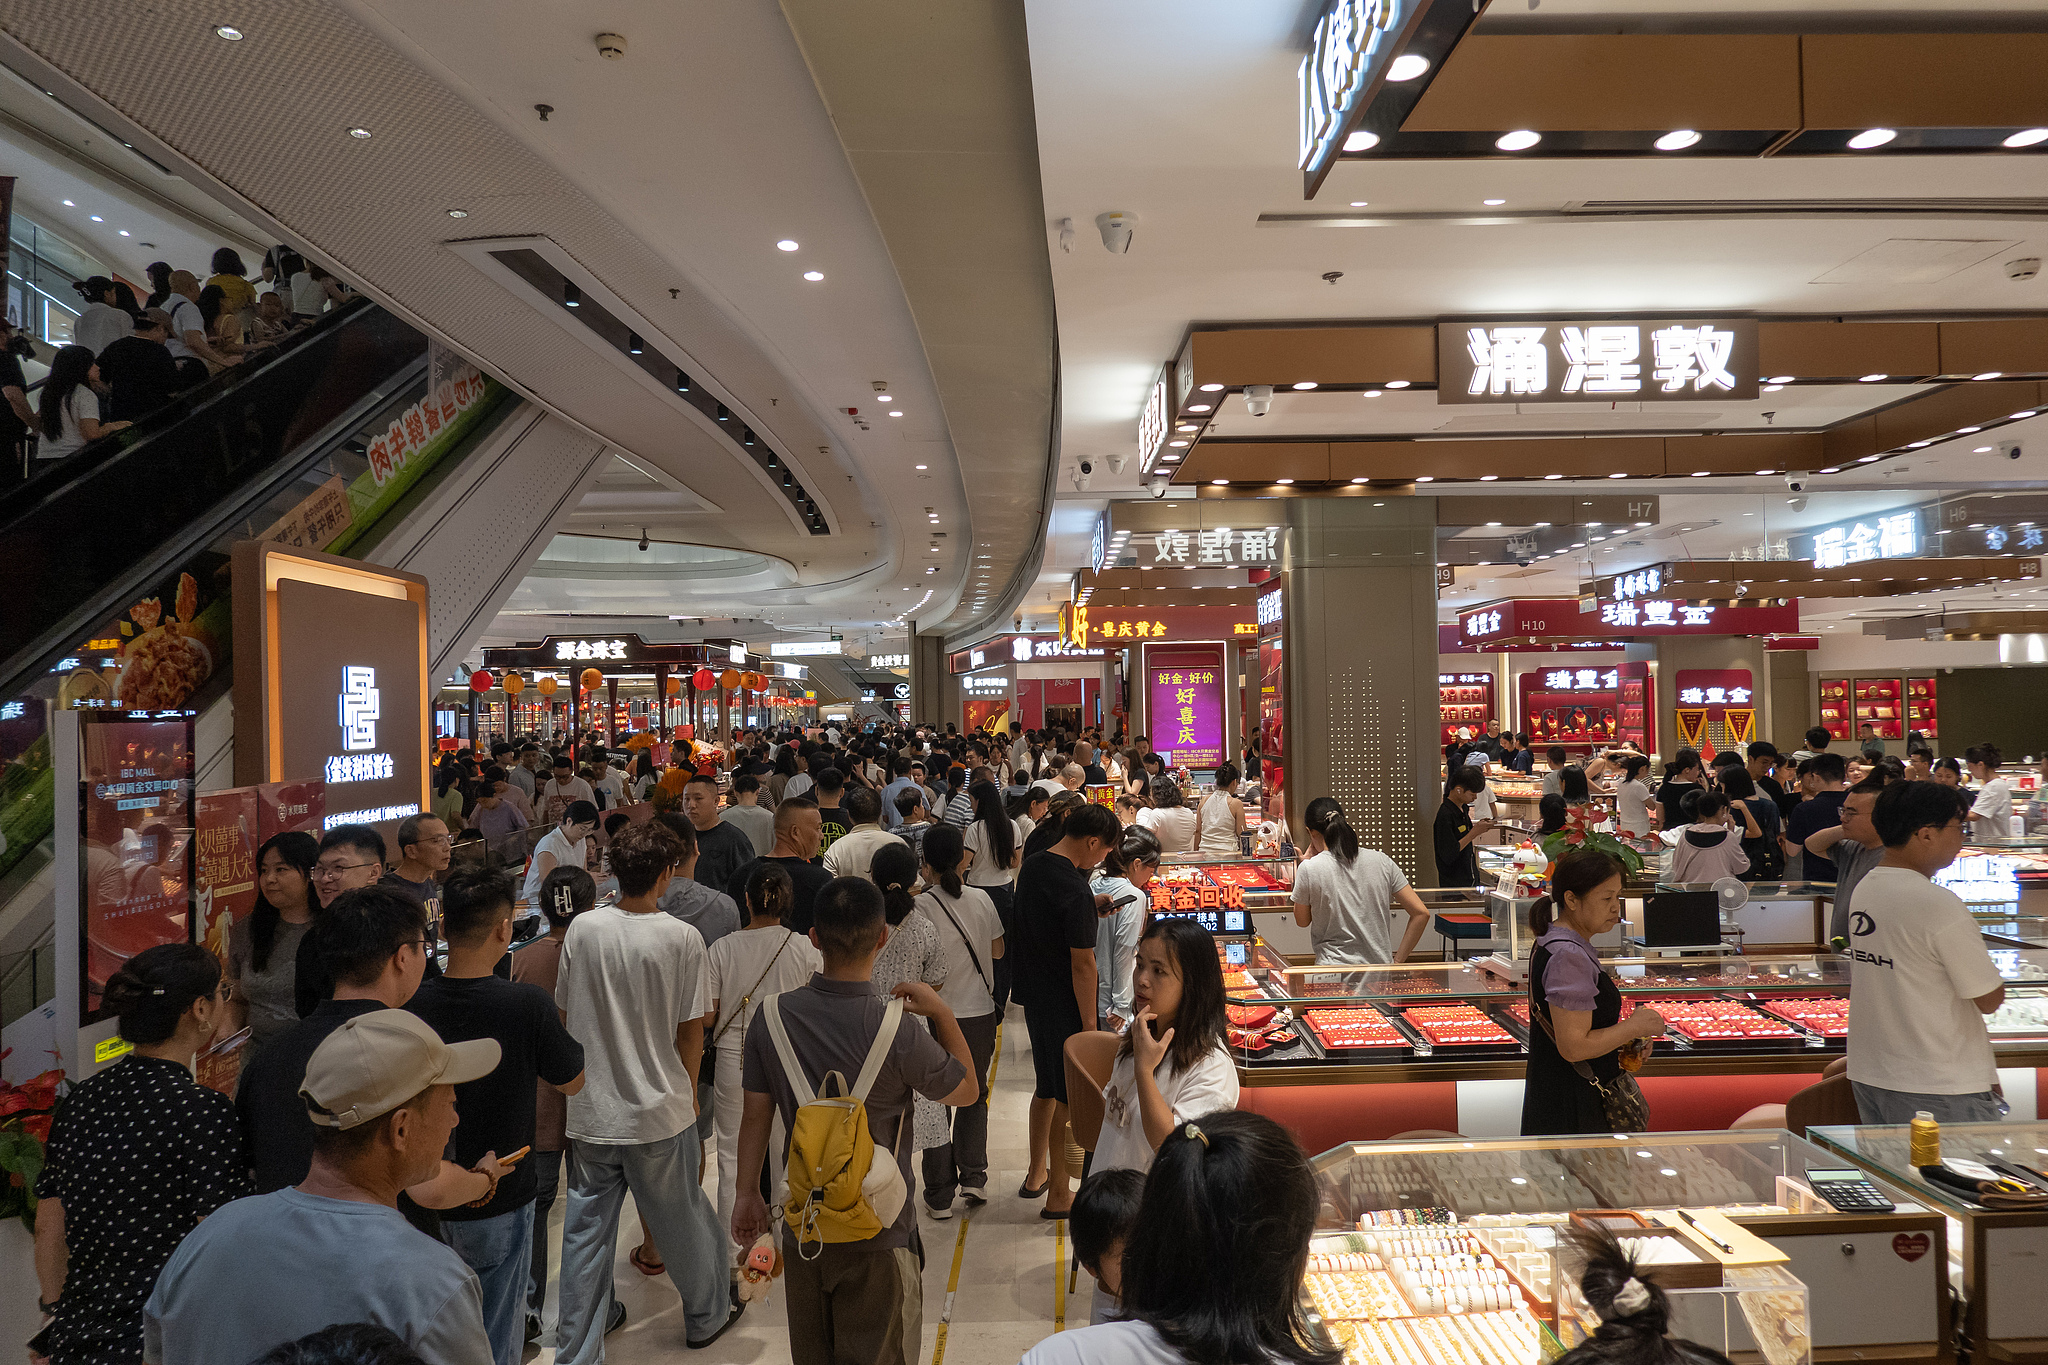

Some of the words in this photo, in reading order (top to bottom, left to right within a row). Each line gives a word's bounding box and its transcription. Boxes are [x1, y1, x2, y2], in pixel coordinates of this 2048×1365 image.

[1467, 326, 1738, 395] 涌涅敦
[1628, 502, 1653, 517] H7
[1812, 511, 1917, 570] 瑞金福
[1664, 568, 1673, 580] H8
[2019, 563, 2037, 574] H8
[1158, 672, 1214, 685] 好金·好价
[136, 767, 156, 777] MALL
[1098, 787, 1114, 800] 黄金
[1149, 884, 1246, 911] 黄金回收
